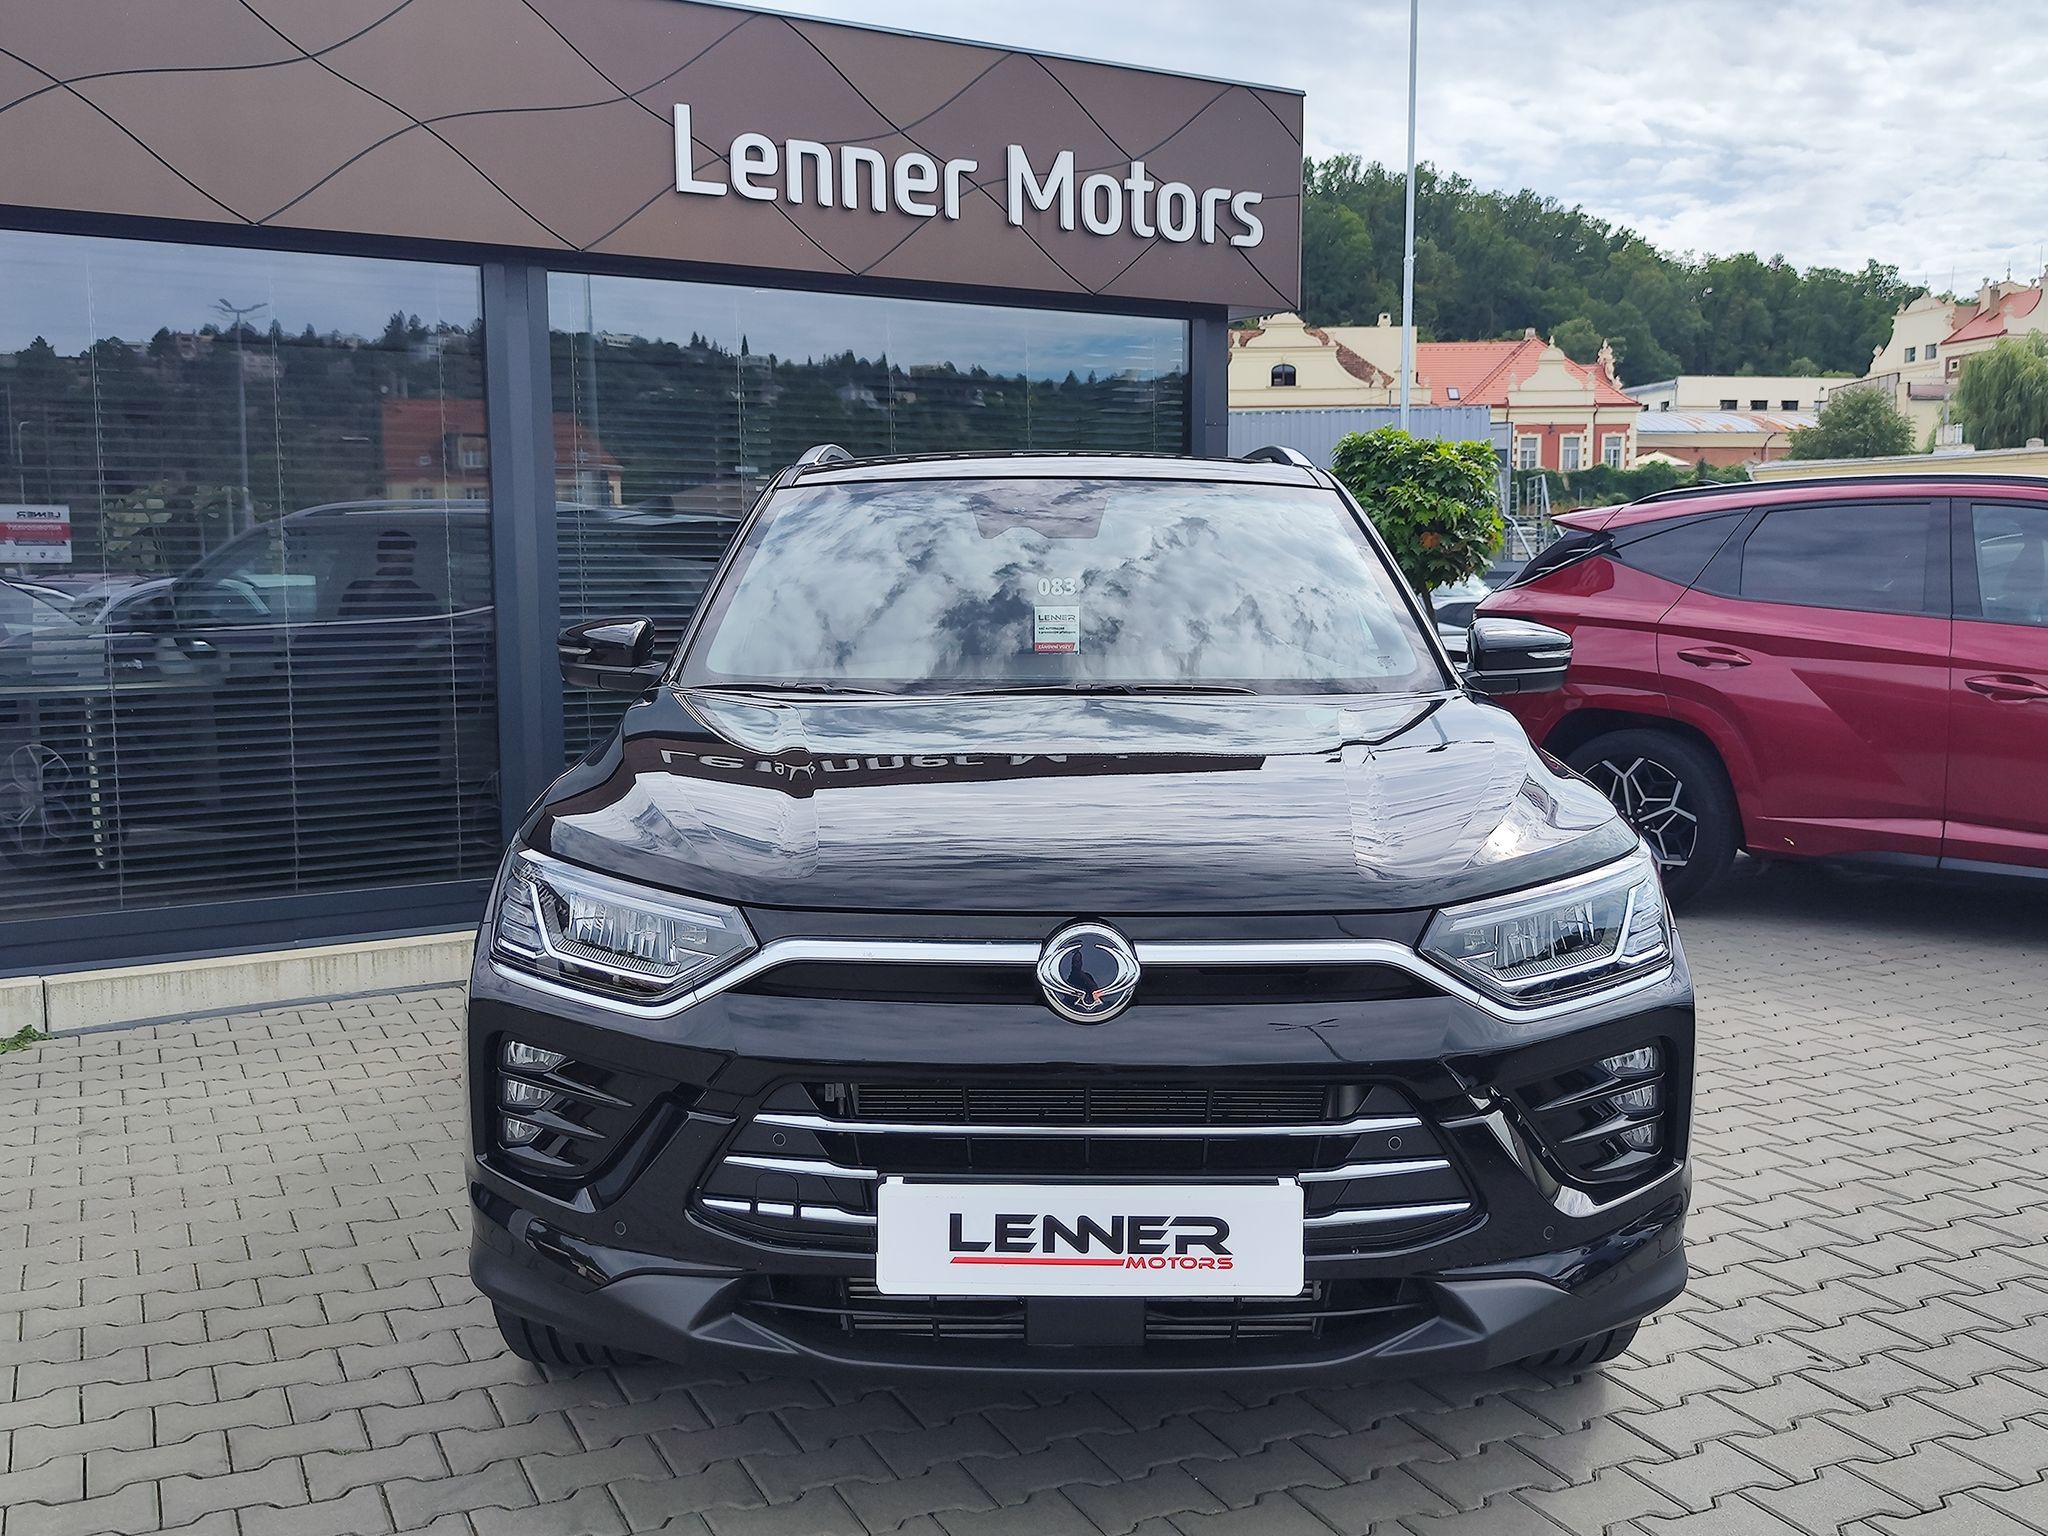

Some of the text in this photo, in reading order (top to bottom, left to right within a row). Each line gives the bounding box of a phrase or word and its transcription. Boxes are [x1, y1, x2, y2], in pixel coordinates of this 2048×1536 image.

[673, 103, 1264, 249] Lenner Motors
[1038, 577, 1077, 596] 083
[949, 1213, 1233, 1255] LENNER
[1125, 1256, 1234, 1270] MOTORS
